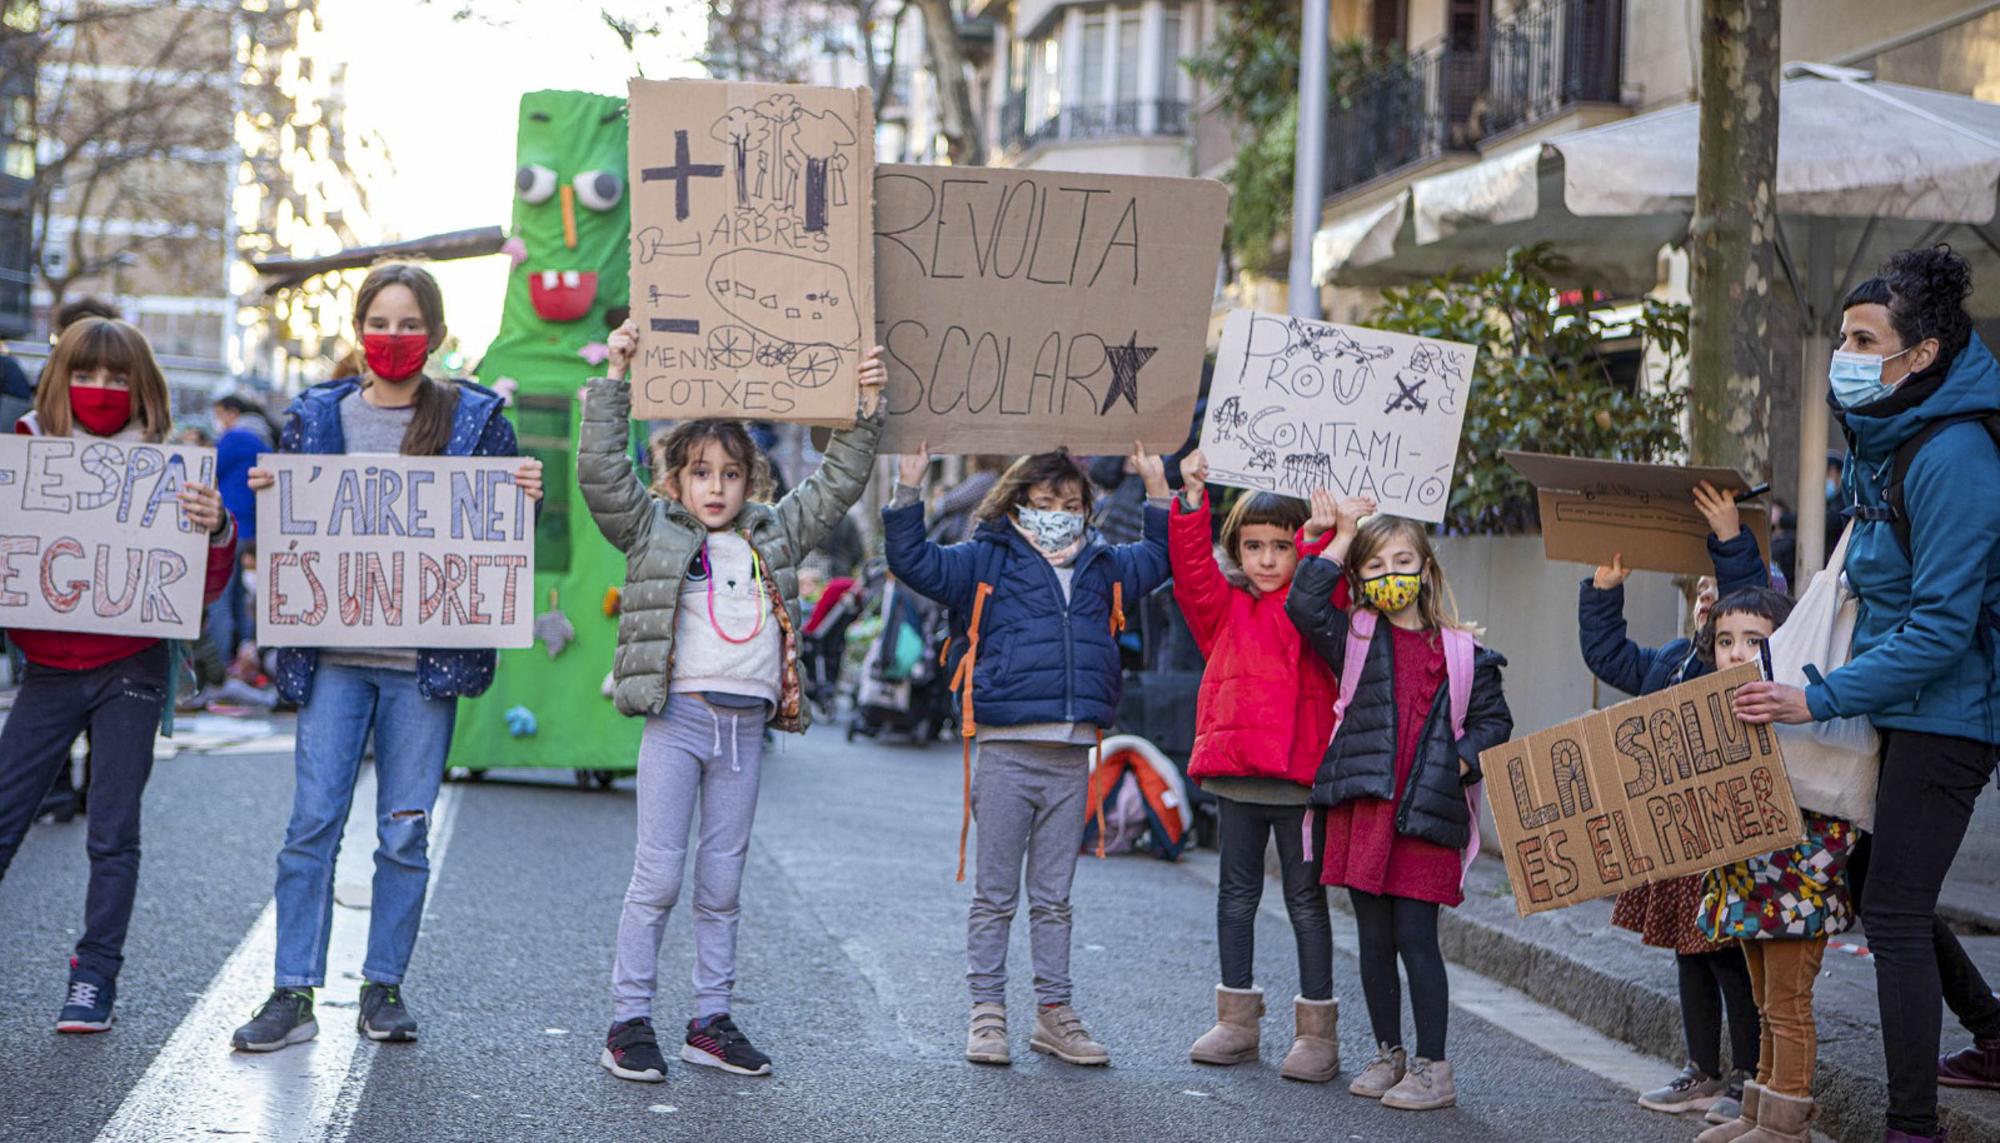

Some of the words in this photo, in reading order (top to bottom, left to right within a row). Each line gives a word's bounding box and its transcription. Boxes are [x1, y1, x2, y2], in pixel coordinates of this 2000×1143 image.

[708, 213, 831, 252] ARBRES
[873, 173, 1139, 288] REVOLTA
[644, 374, 796, 414] COTXES
[875, 319, 1108, 416] SCOLAR
[1238, 311, 1369, 406] PROU
[450, 469, 525, 542] NET
[1327, 464, 1450, 506] NACIÓ
[269, 540, 328, 626] ÉS
[338, 550, 403, 627] UN
[418, 552, 527, 627] DRET
[1507, 737, 1594, 830] LA
[1516, 829, 1579, 904] ES
[1585, 810, 1654, 885] EL
[1647, 765, 1789, 866] PRIMER
